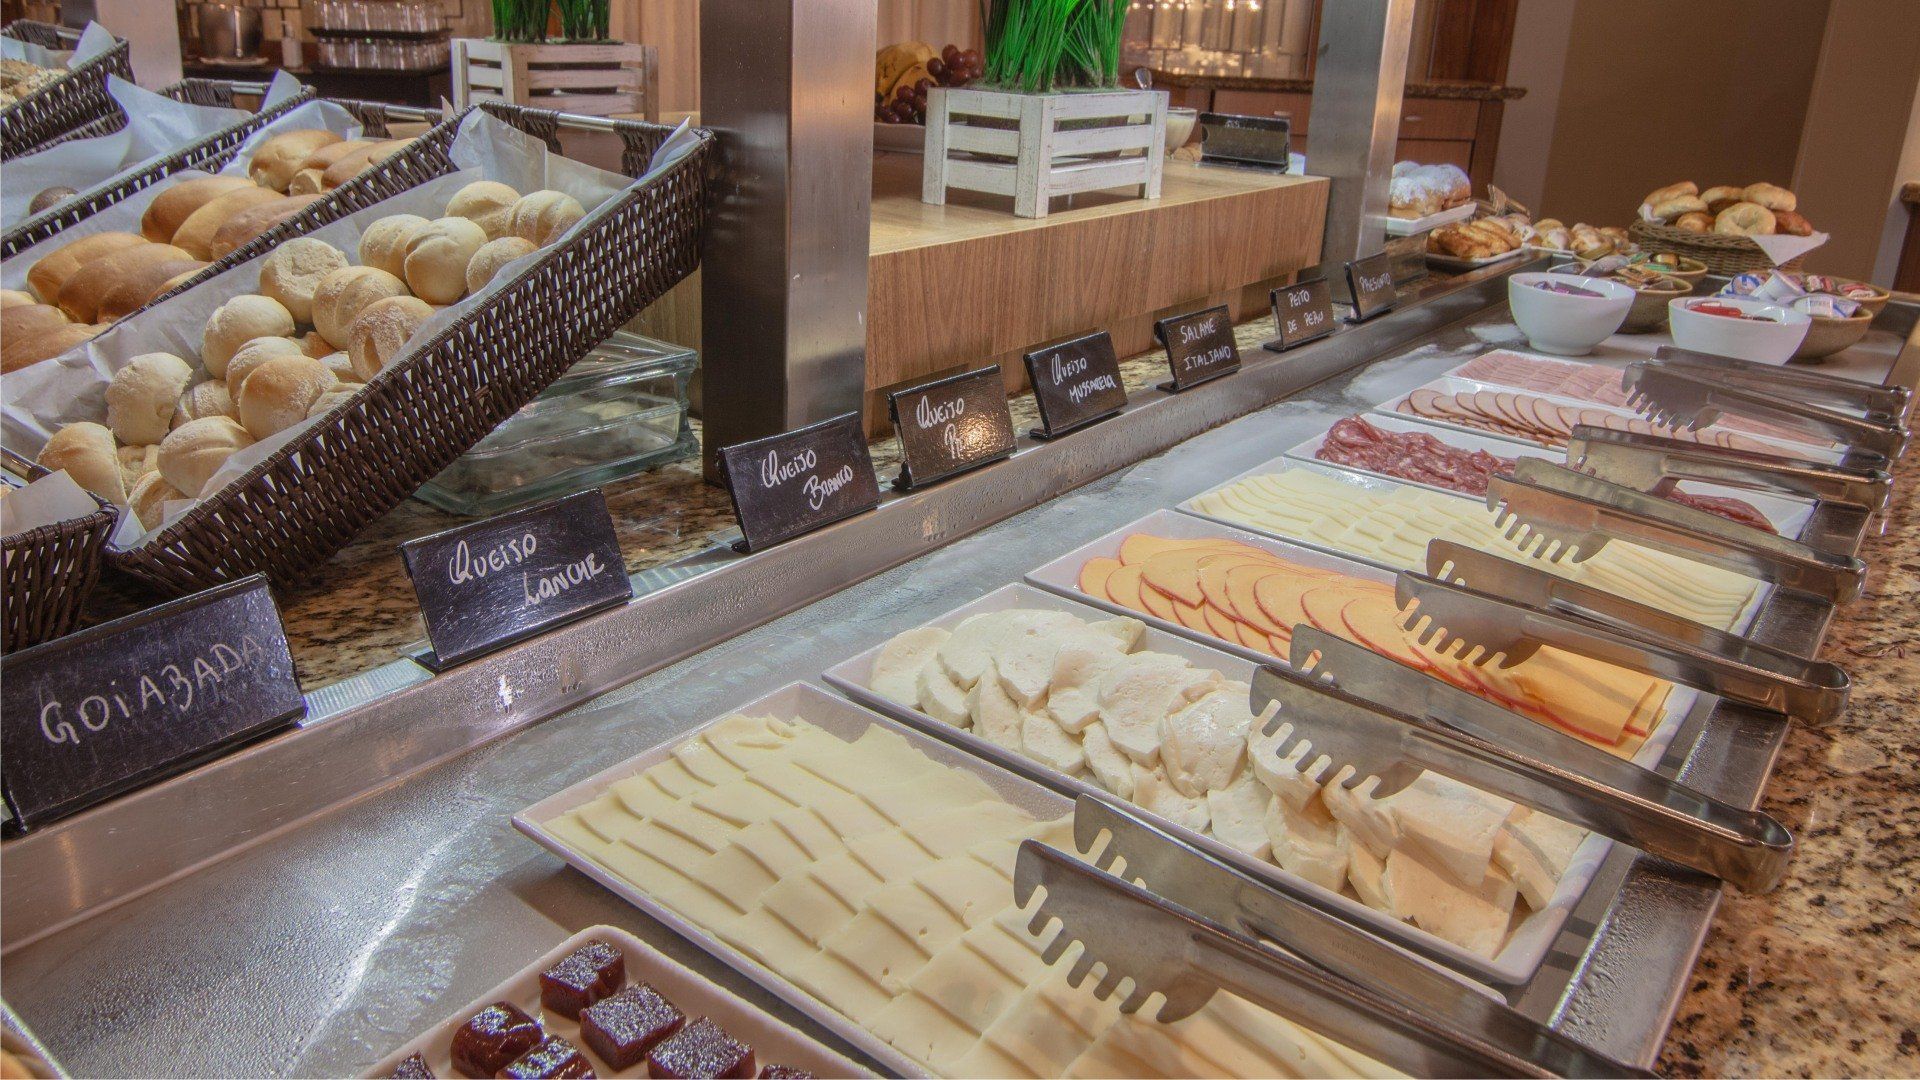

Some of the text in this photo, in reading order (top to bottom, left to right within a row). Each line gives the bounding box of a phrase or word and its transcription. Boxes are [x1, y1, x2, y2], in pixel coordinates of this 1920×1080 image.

[1180, 318, 1216, 344] SALAME
[1287, 319, 1298, 334] DE
[1183, 345, 1231, 371] ITALIANO
